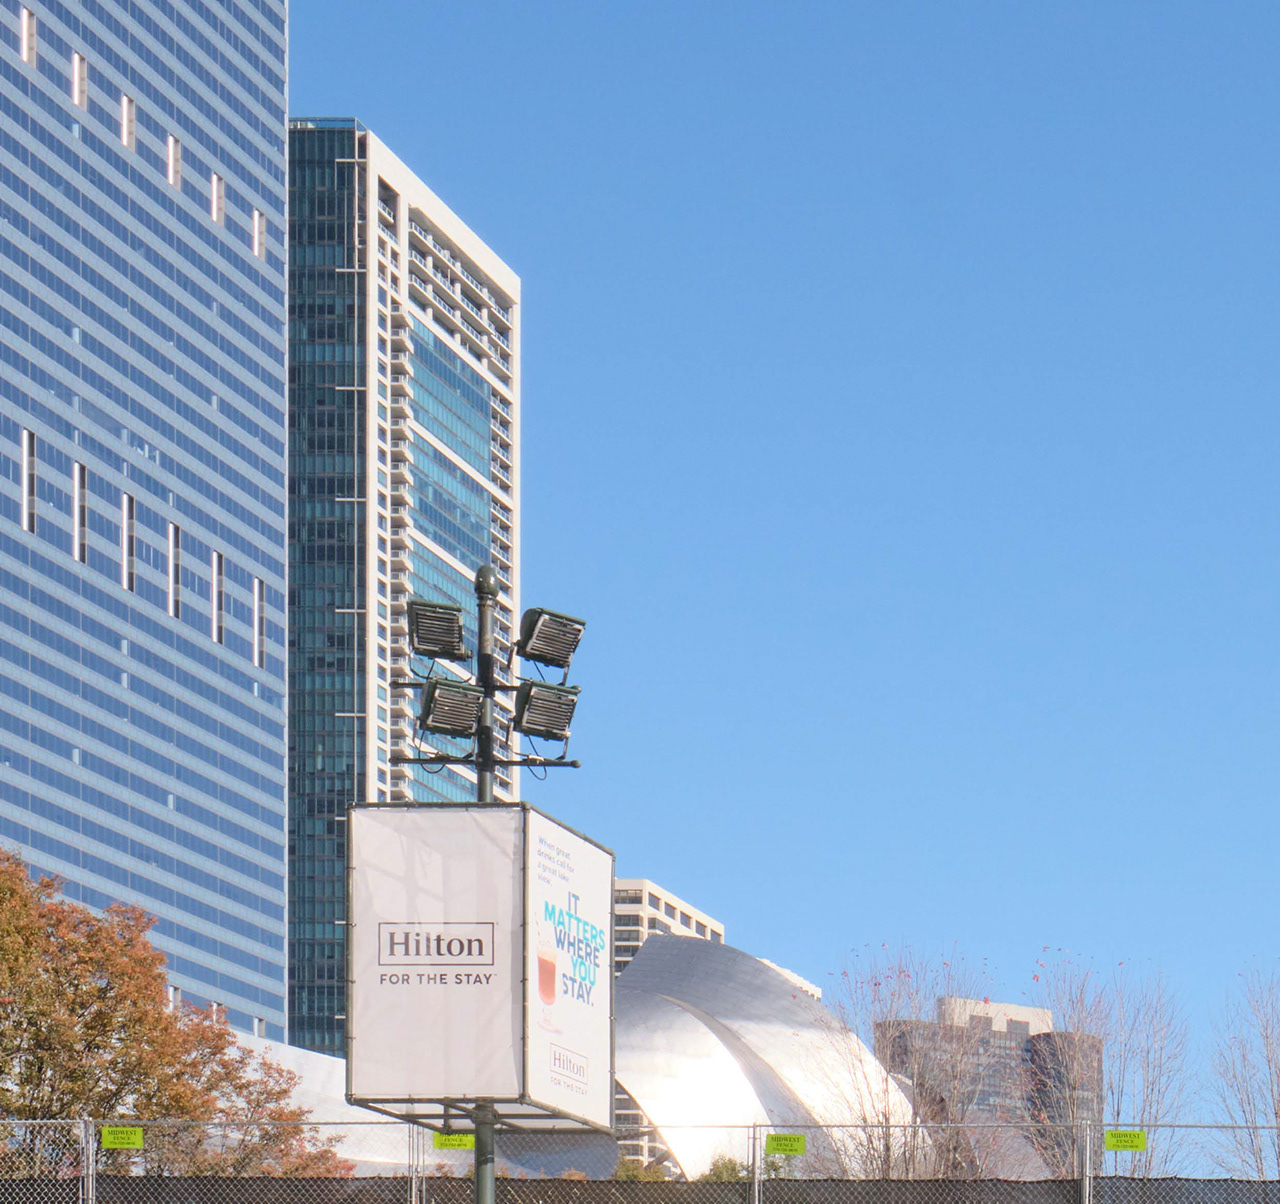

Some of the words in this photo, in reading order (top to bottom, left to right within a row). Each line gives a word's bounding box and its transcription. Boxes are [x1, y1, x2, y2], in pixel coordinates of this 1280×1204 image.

[567, 891, 580, 914] IT
[544, 900, 605, 950] MATTERS
[388, 931, 484, 956] Hilton
[554, 926, 600, 968] WHERE
[380, 973, 410, 985] FOR
[417, 973, 448, 985] THE
[455, 973, 493, 985] STAY
[571, 955, 596, 987] YOU
[562, 973, 595, 1007] STAY.
[554, 1050, 585, 1078] Hilton
